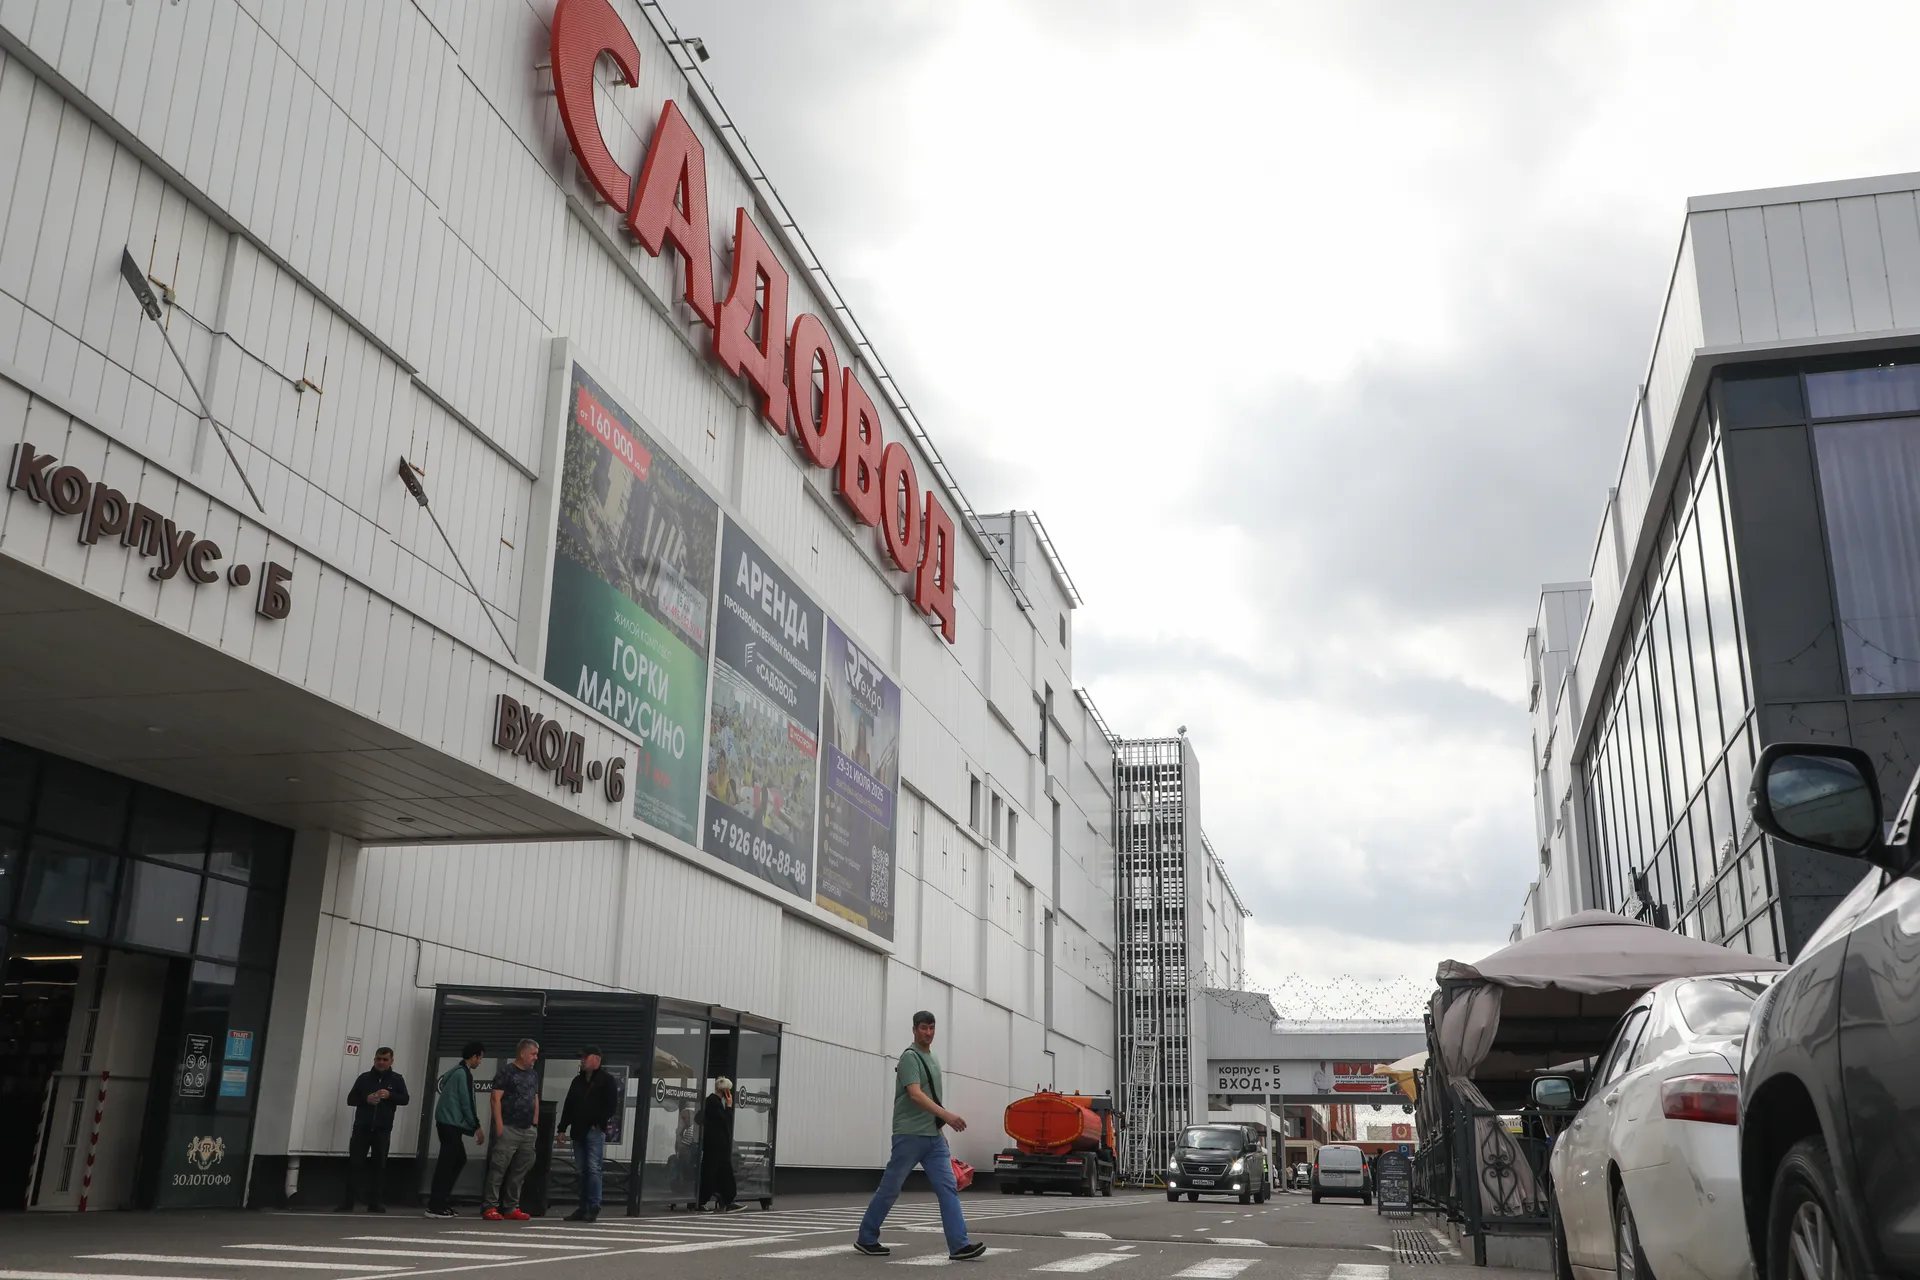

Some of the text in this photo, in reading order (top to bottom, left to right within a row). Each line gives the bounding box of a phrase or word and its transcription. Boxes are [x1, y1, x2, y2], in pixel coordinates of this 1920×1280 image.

[551, 0, 956, 645] САДОВОД
[580, 409, 588, 420] от
[590, 404, 610, 441] 160
[613, 427, 634, 463] 000
[7, 442, 293, 620] корпус Б
[614, 609, 640, 638] ЖИЛОЙ
[736, 551, 809, 651] АРЕНДА
[724, 593, 783, 656] ПРОИЗВОДСТВЕННЫХ
[783, 647, 817, 684] ПОМЕЩЕНИЙ
[612, 636, 669, 704] ГОРКИ
[756, 663, 798, 707] «САДОВОД»
[861, 680, 882, 710] expo
[577, 664, 685, 760] МАРУСИНО
[492, 694, 626, 803] ВХОД 6
[836, 756, 853, 779] 29-31
[854, 767, 871, 792] ИЮЛЯ
[712, 817, 728, 843] +7
[729, 823, 751, 856] 926
[752, 836, 807, 885] 602-88-88
[666, 1088, 677, 1097] МЕСТО
[684, 1091, 698, 1099] КУРЕНИЯ
[1219, 1065, 1280, 1077] корпус Б
[1219, 1078, 1281, 1091] ВХОД 5
[747, 1095, 756, 1103] МЕСТО
[173, 1174, 232, 1186] ЗОЛОТОФФ
